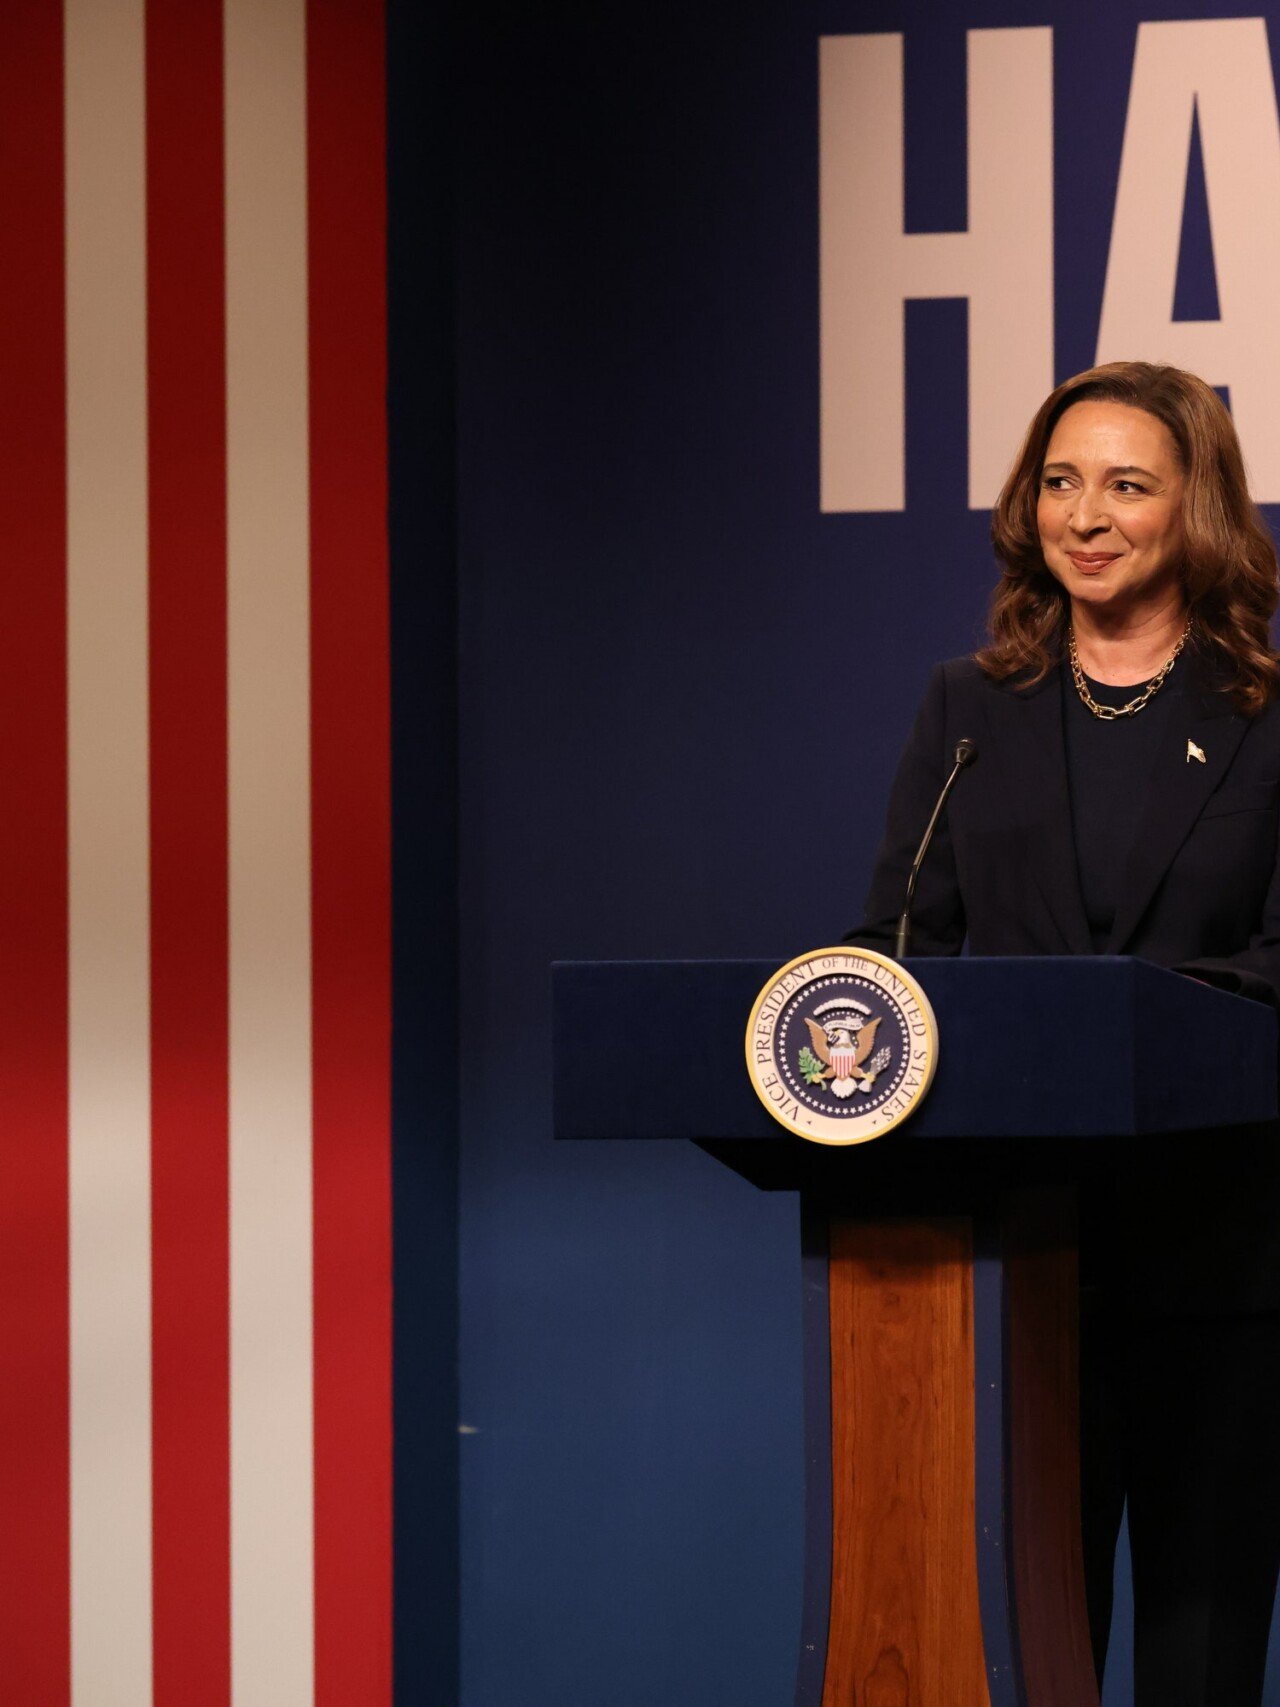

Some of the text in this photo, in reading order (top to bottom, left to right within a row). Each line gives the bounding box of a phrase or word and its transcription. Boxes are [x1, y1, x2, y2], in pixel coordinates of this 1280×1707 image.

[756, 956, 927, 1122] VICE PRESIDENT OF THE UNITED STATES
